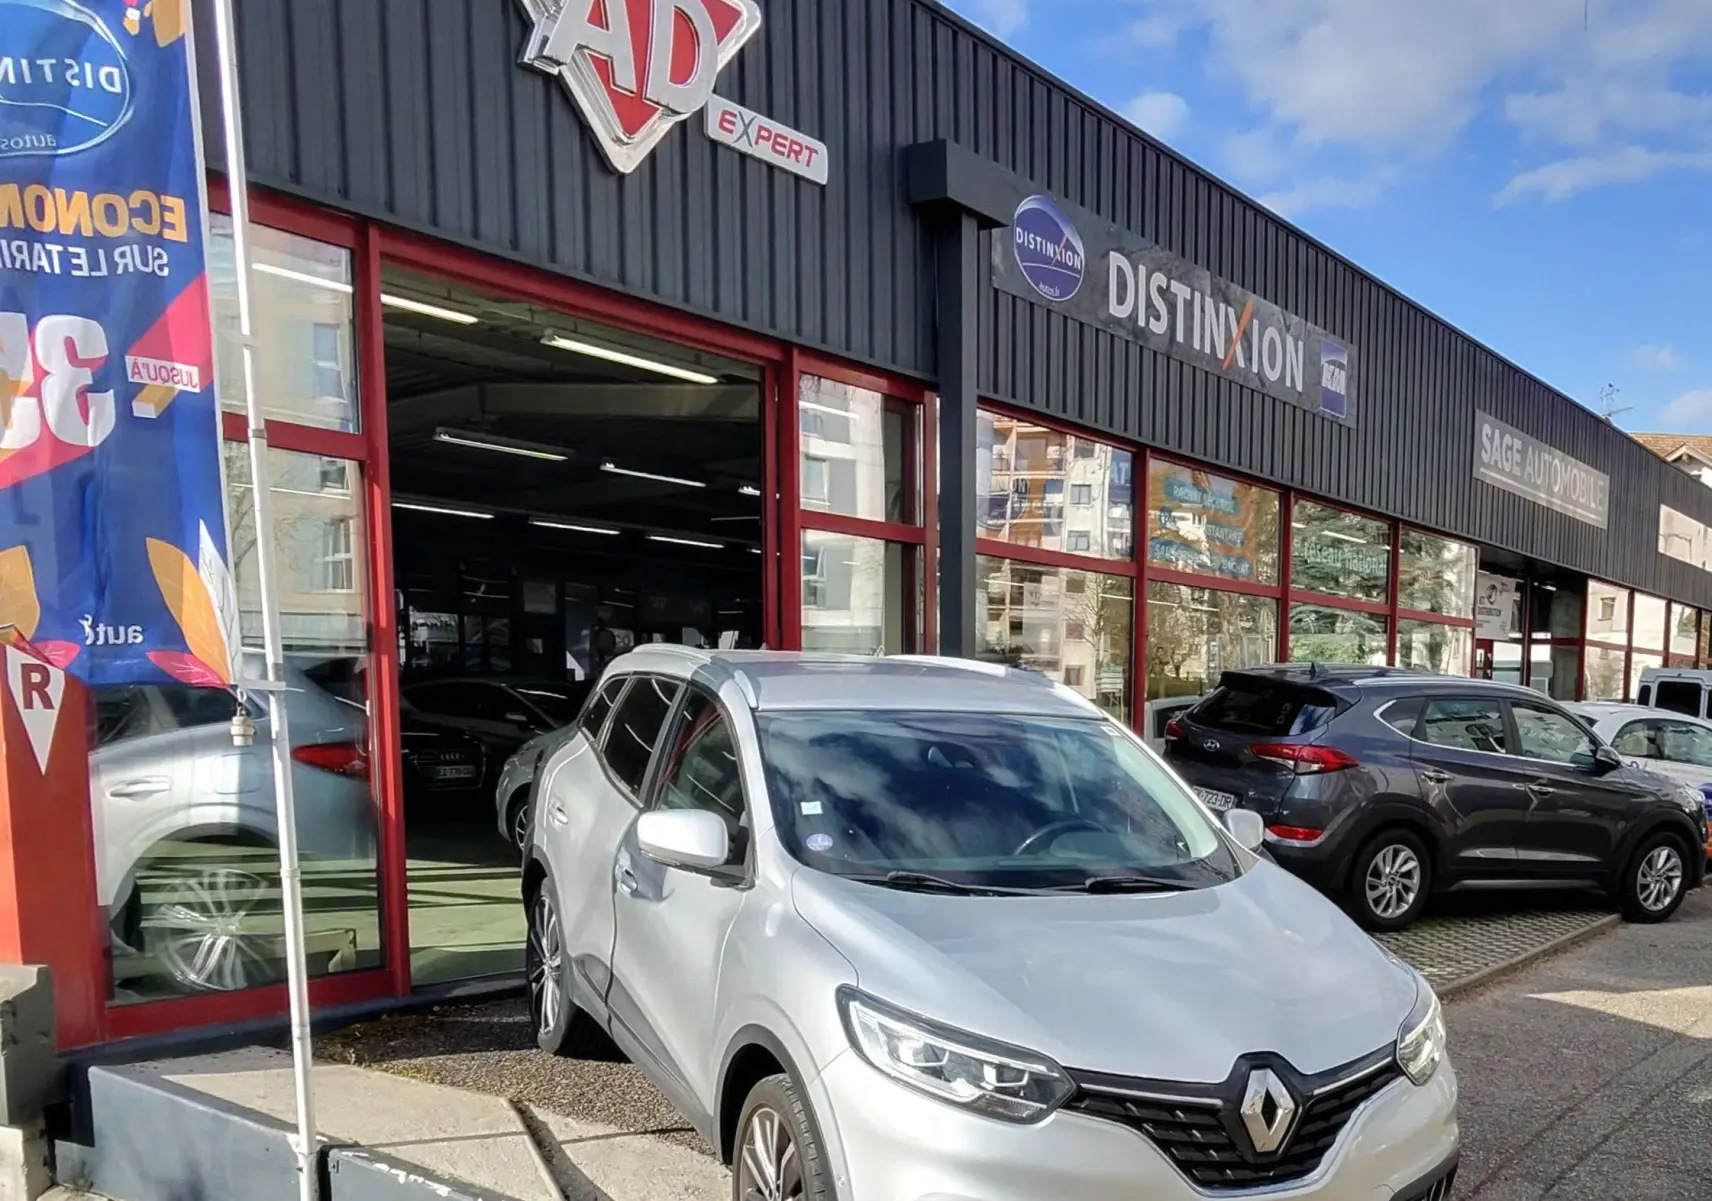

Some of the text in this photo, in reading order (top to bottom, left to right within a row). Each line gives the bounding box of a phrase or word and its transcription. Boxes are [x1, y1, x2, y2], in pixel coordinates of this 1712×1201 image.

[544, 0, 718, 114] AD
[717, 109, 819, 168] EXPERT
[1015, 227, 1082, 271] DISTINXION
[1108, 250, 1304, 393] DISTINXION
[1480, 423, 1604, 512] SAGE AUTOMOBILE
[20, 663, 56, 710] R
